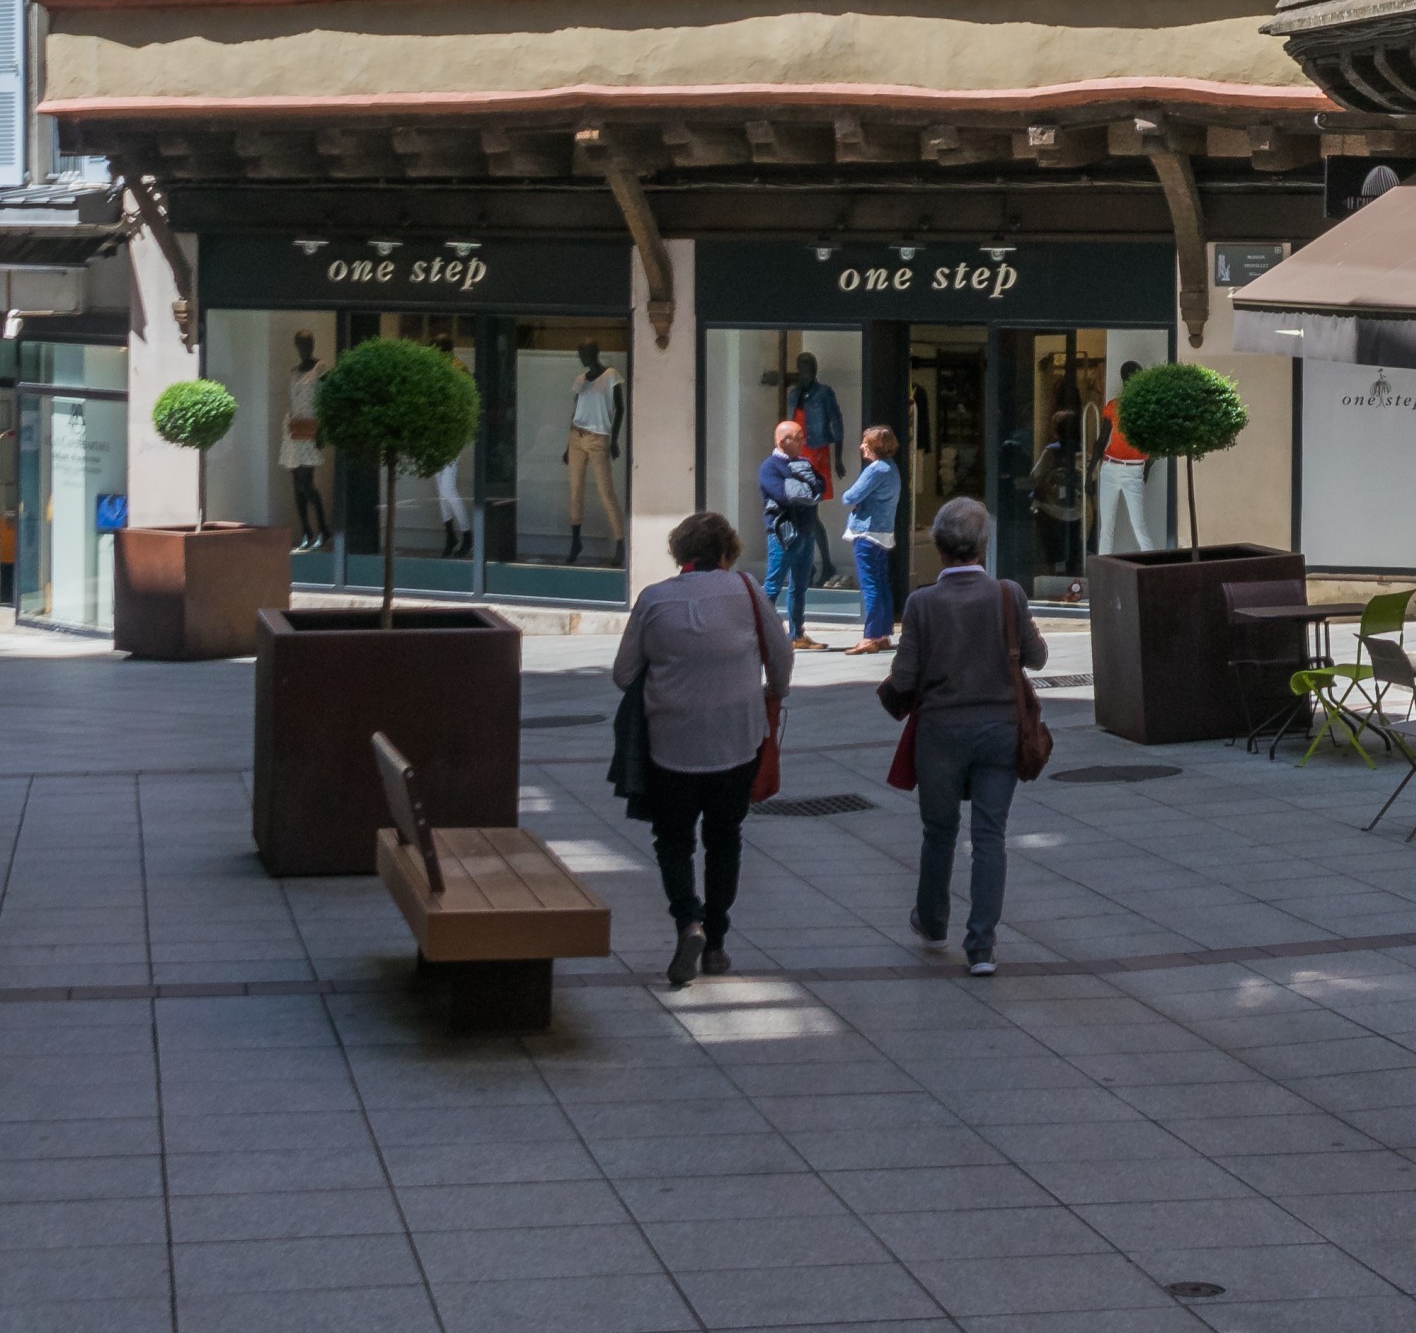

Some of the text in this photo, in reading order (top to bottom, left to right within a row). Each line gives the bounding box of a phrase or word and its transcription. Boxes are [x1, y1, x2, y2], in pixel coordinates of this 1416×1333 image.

[327, 257, 487, 291] one step
[838, 262, 1018, 299] one step
[1342, 395, 1376, 406] one
